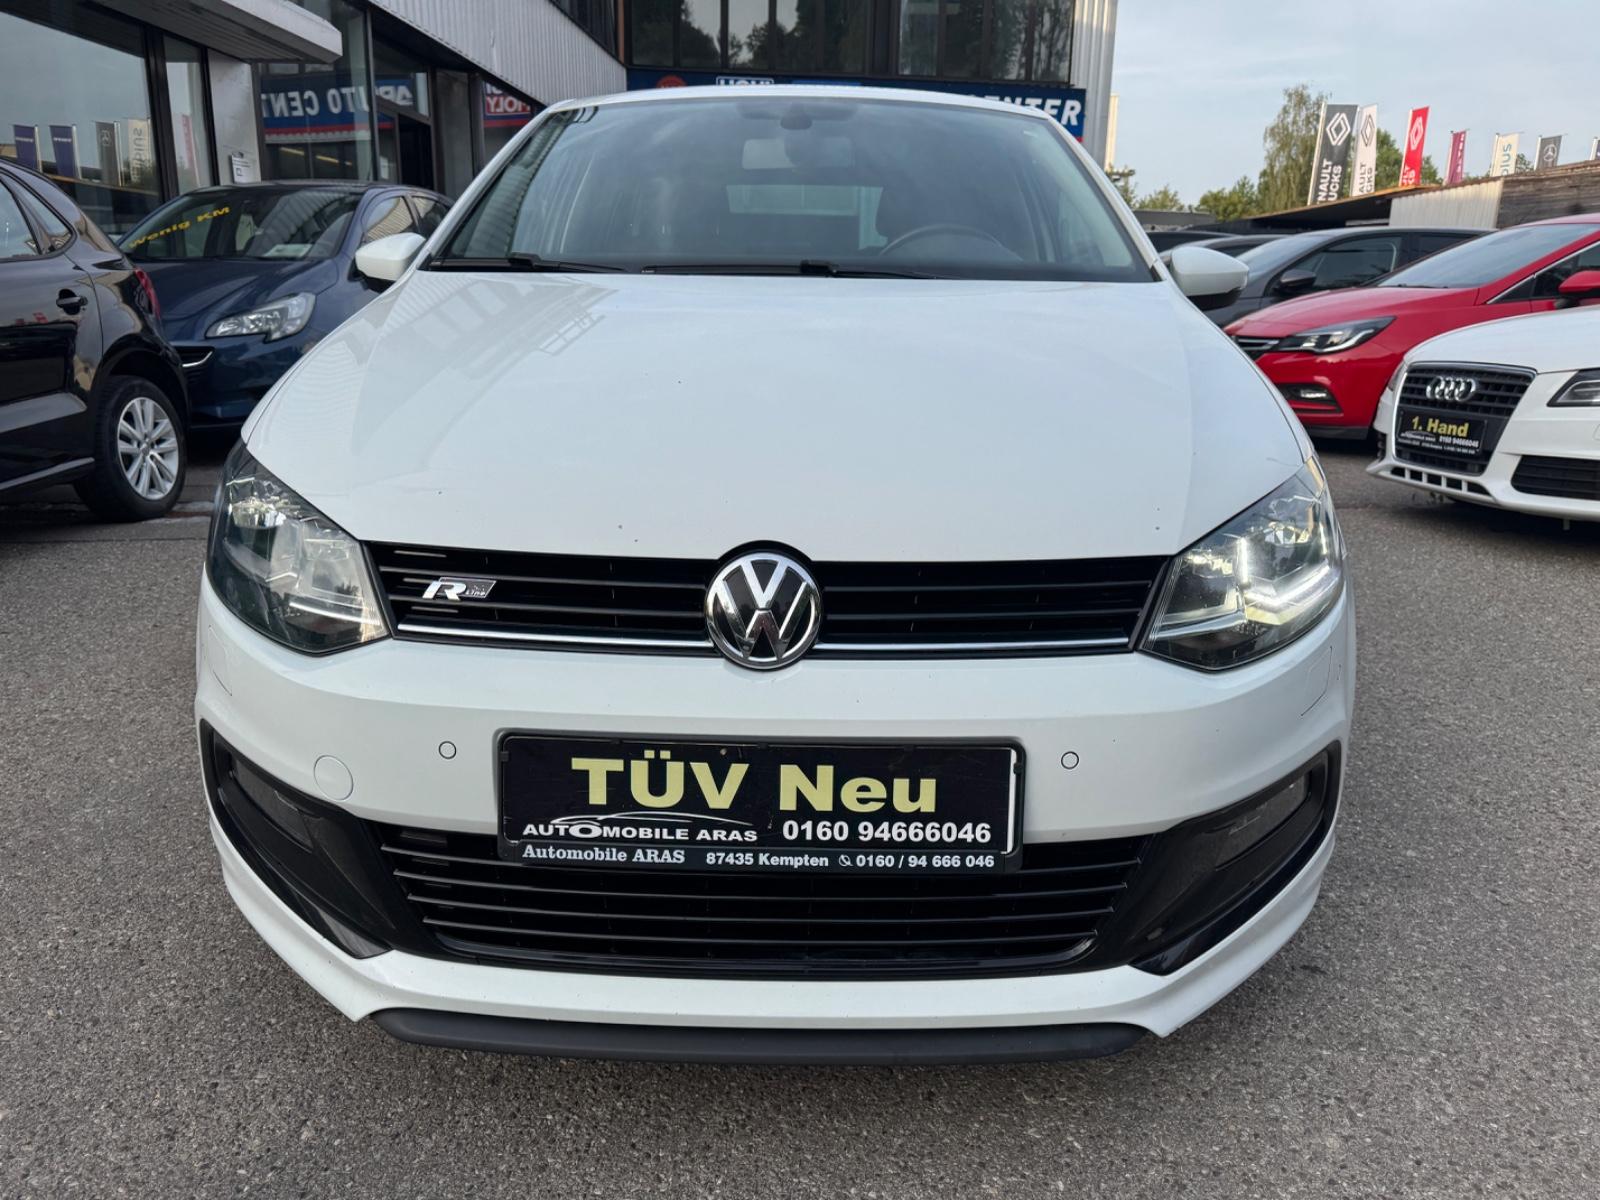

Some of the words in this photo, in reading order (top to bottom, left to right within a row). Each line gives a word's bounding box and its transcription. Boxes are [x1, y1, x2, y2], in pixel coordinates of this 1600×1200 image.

[197, 207, 230, 222] KM
[1411, 416, 1423, 431] 1.
[1426, 418, 1469, 437] Hand
[422, 581, 466, 600] R
[571, 749, 750, 810] TÜV
[779, 763, 937, 813] Neu
[522, 821, 690, 841] AUTOMOBILE
[695, 829, 758, 842] ARAS
[782, 820, 849, 842] 0160
[858, 821, 992, 843] 94666046
[522, 844, 627, 862] Automobile
[632, 849, 686, 864] ARAS
[706, 853, 754, 866] 87435
[758, 853, 829, 868] Kempten
[856, 855, 895, 868] 0160
[908, 855, 927, 868] 94
[931, 856, 961, 868] 666
[965, 856, 995, 868] 046
